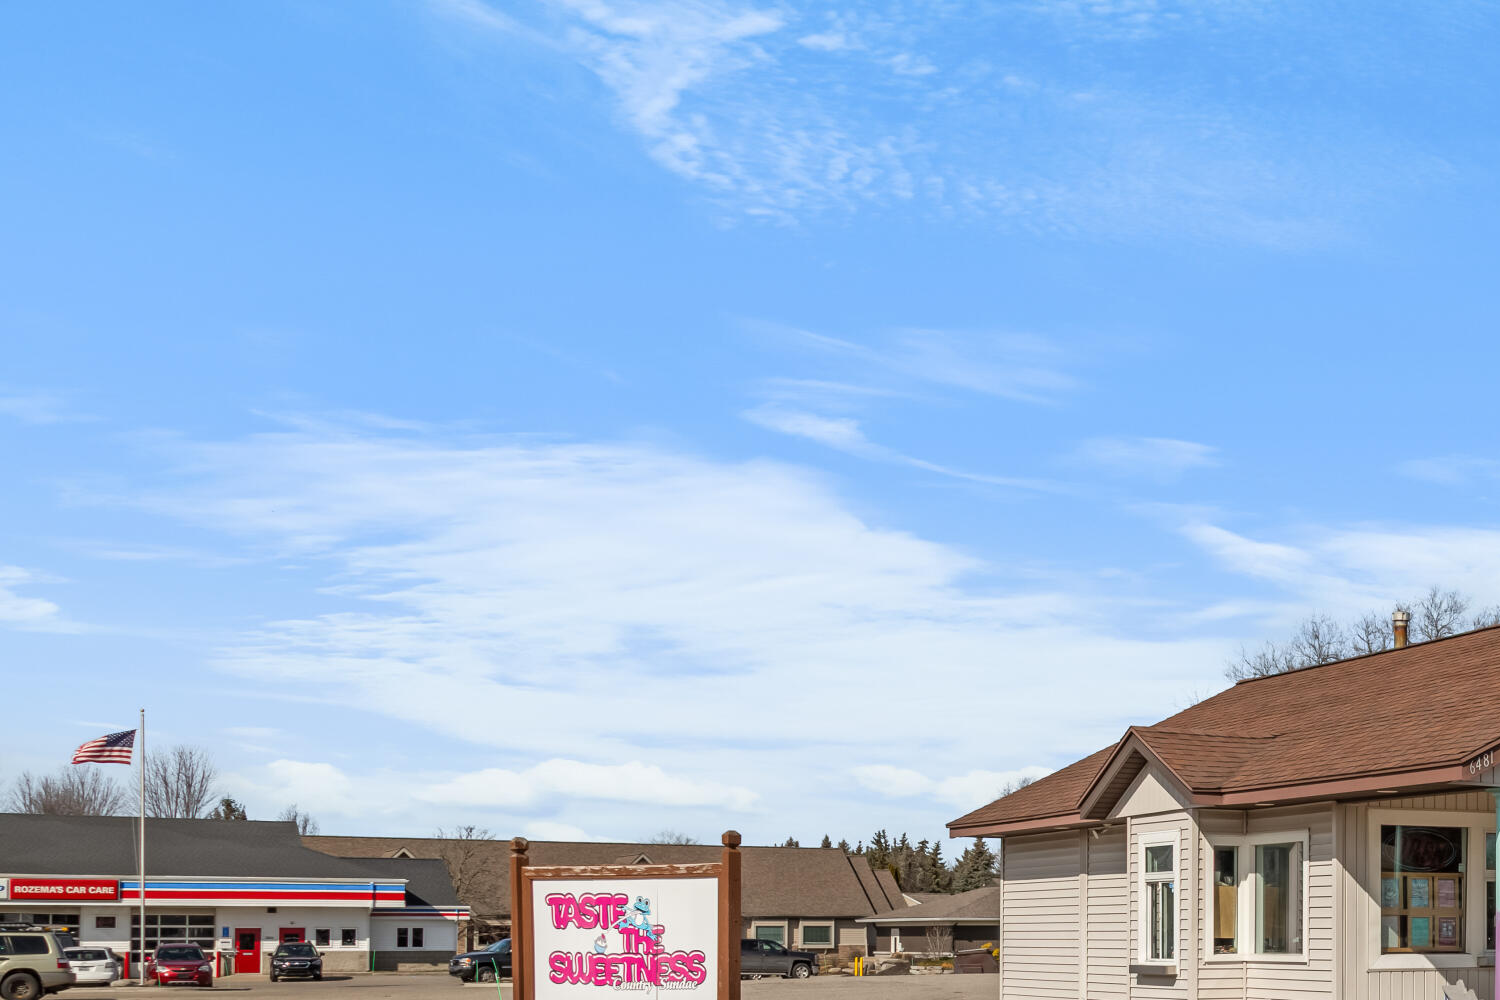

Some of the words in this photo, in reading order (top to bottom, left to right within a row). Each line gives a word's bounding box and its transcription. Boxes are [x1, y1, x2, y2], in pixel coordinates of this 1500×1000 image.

[13, 885, 64, 894] ROZEMA'S
[65, 886, 86, 894] CAR
[88, 886, 115, 894] CARE
[545, 892, 629, 930] TASTE
[618, 924, 665, 955] THE
[549, 950, 707, 986] SWEETNESS
[612, 977, 653, 995] Country
[659, 976, 698, 991] Sundae
